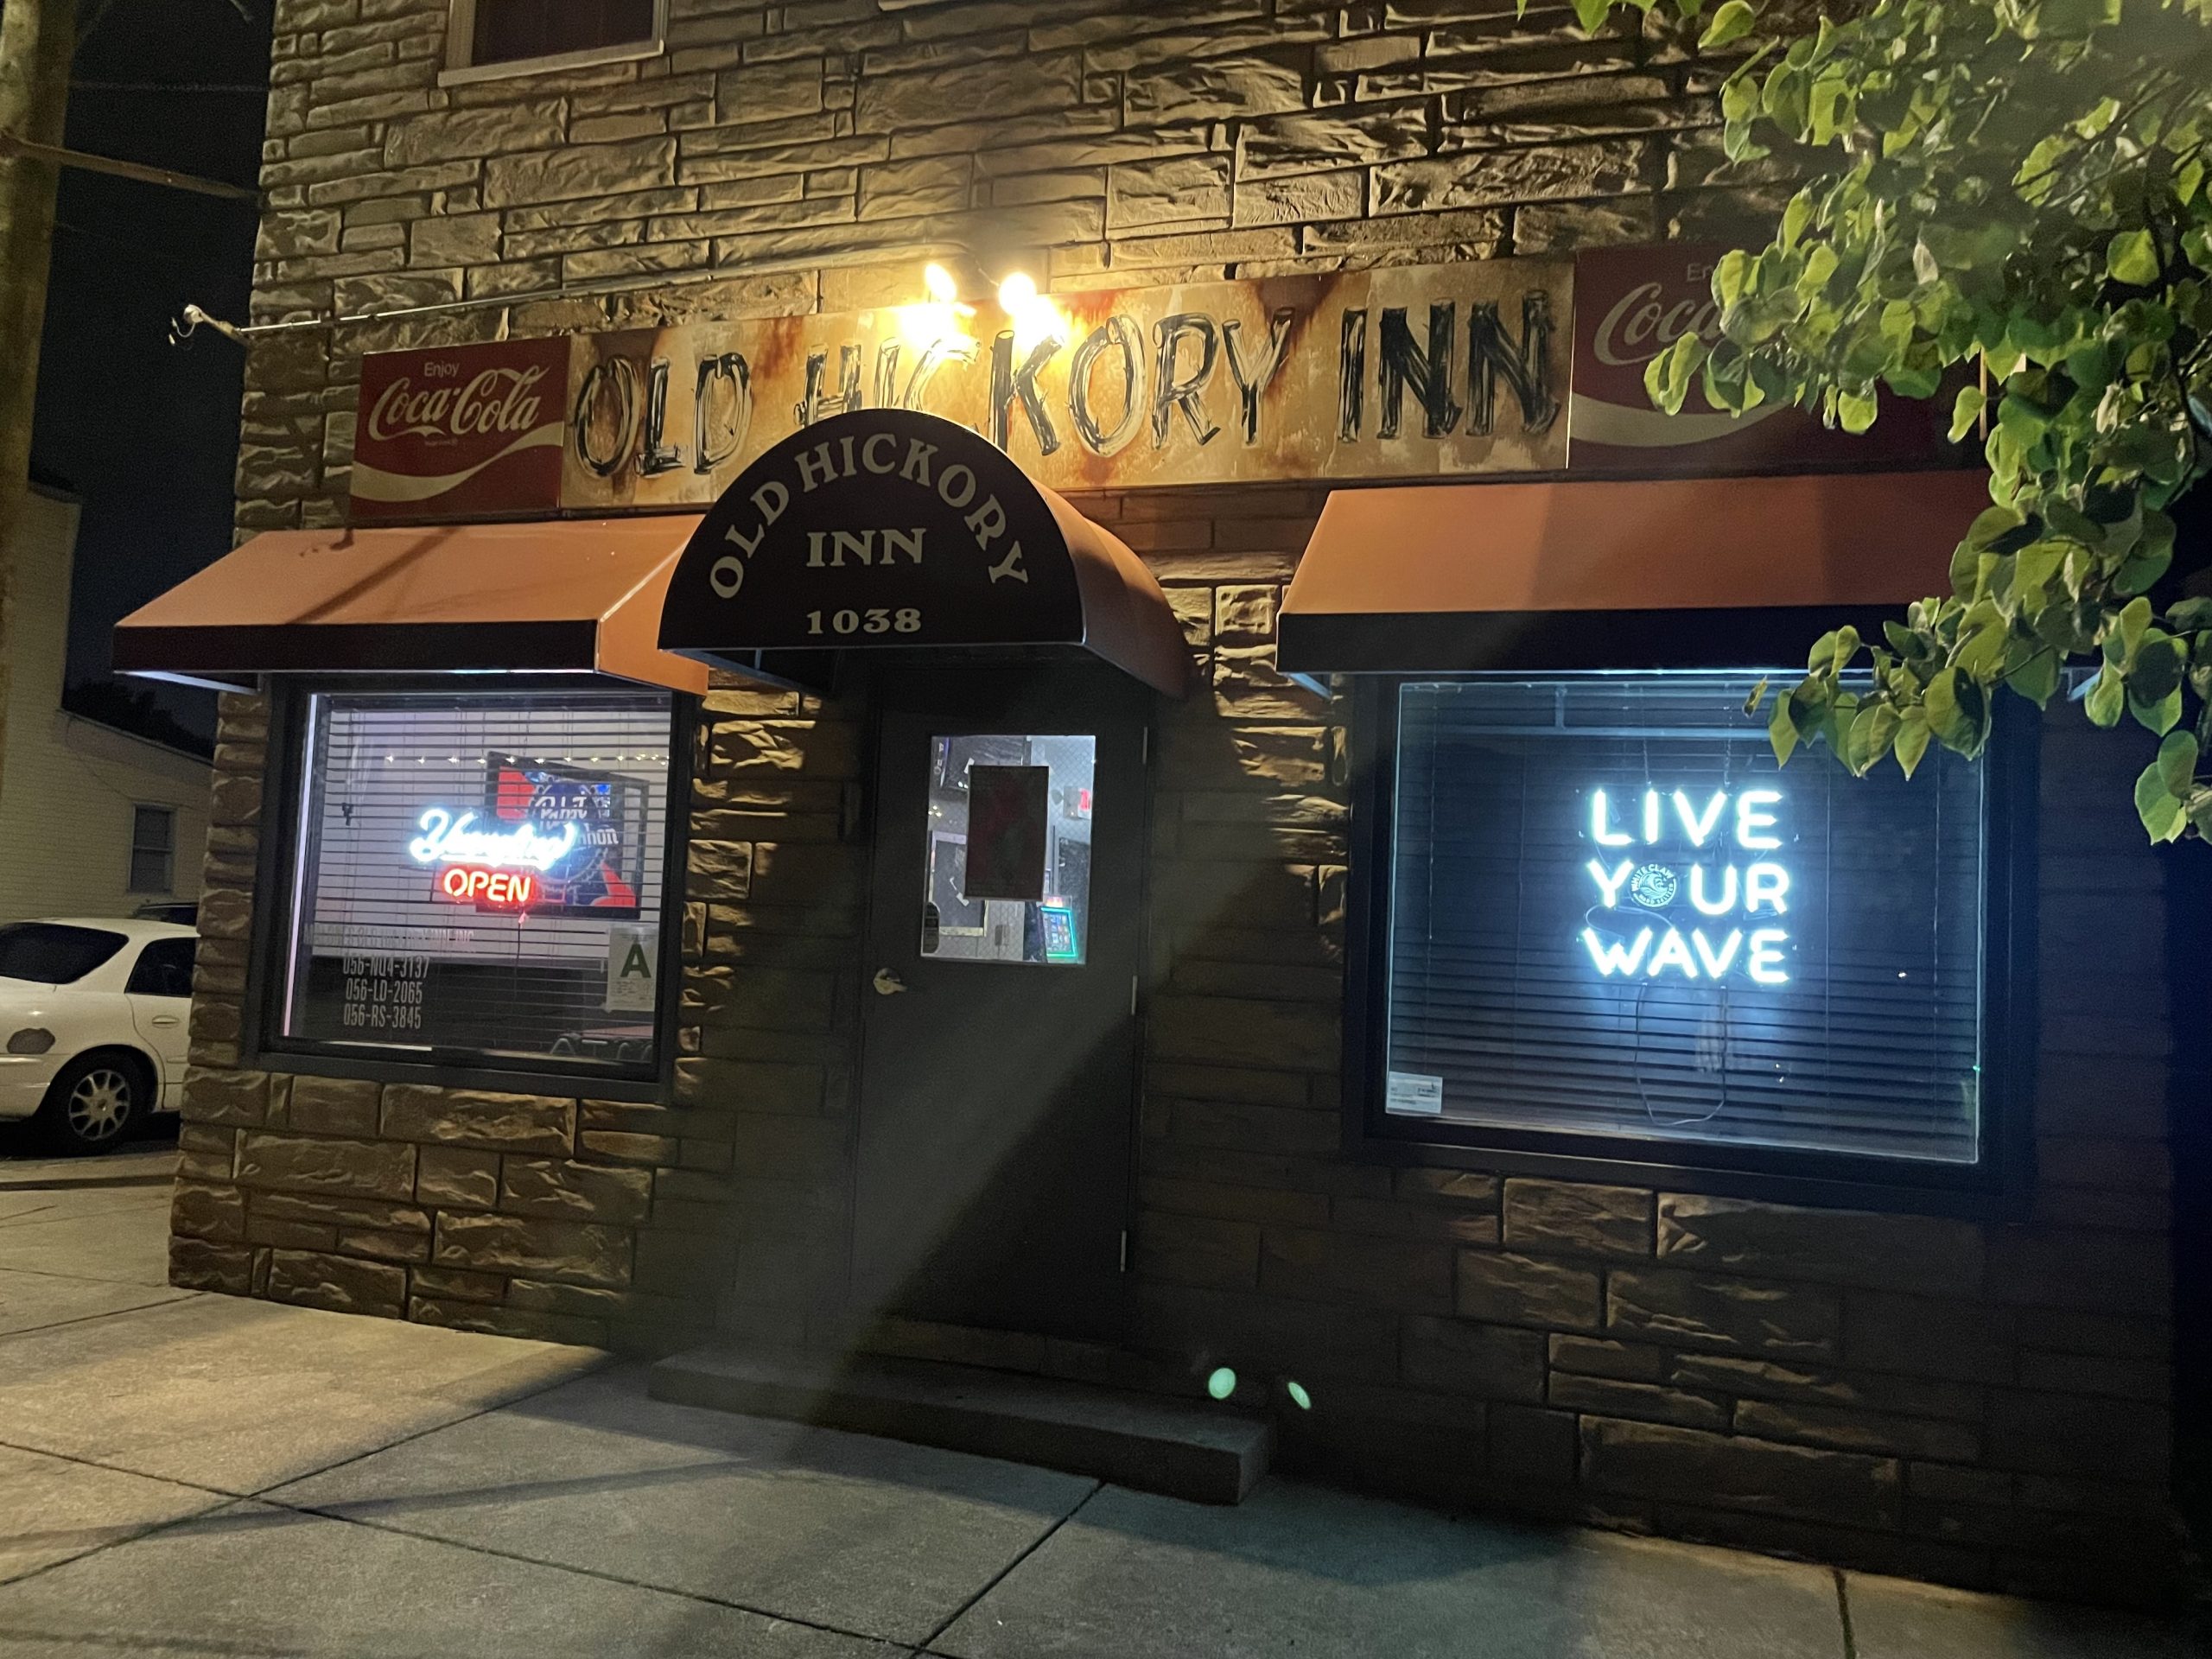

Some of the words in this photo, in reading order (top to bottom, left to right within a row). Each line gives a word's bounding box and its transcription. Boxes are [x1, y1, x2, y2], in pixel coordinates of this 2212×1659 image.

[424, 361, 461, 378] Enjoy
[574, 352, 753, 479] OLD
[1338, 290, 1560, 442] INN
[368, 365, 550, 442] Coca-Cola
[709, 480, 790, 600] OLD
[793, 433, 1028, 585] HICKORY
[806, 528, 927, 568] INN
[806, 607, 922, 634] 1038
[1592, 789, 1784, 849] LIVE
[443, 868, 532, 902] OPEN
[1648, 863, 1675, 880] CLAW
[620, 938, 652, 978] A
[1581, 926, 1790, 983] WAVE
[346, 977, 424, 1005] 056-LD-2065
[343, 1003, 423, 1030] 056-RS-3845
